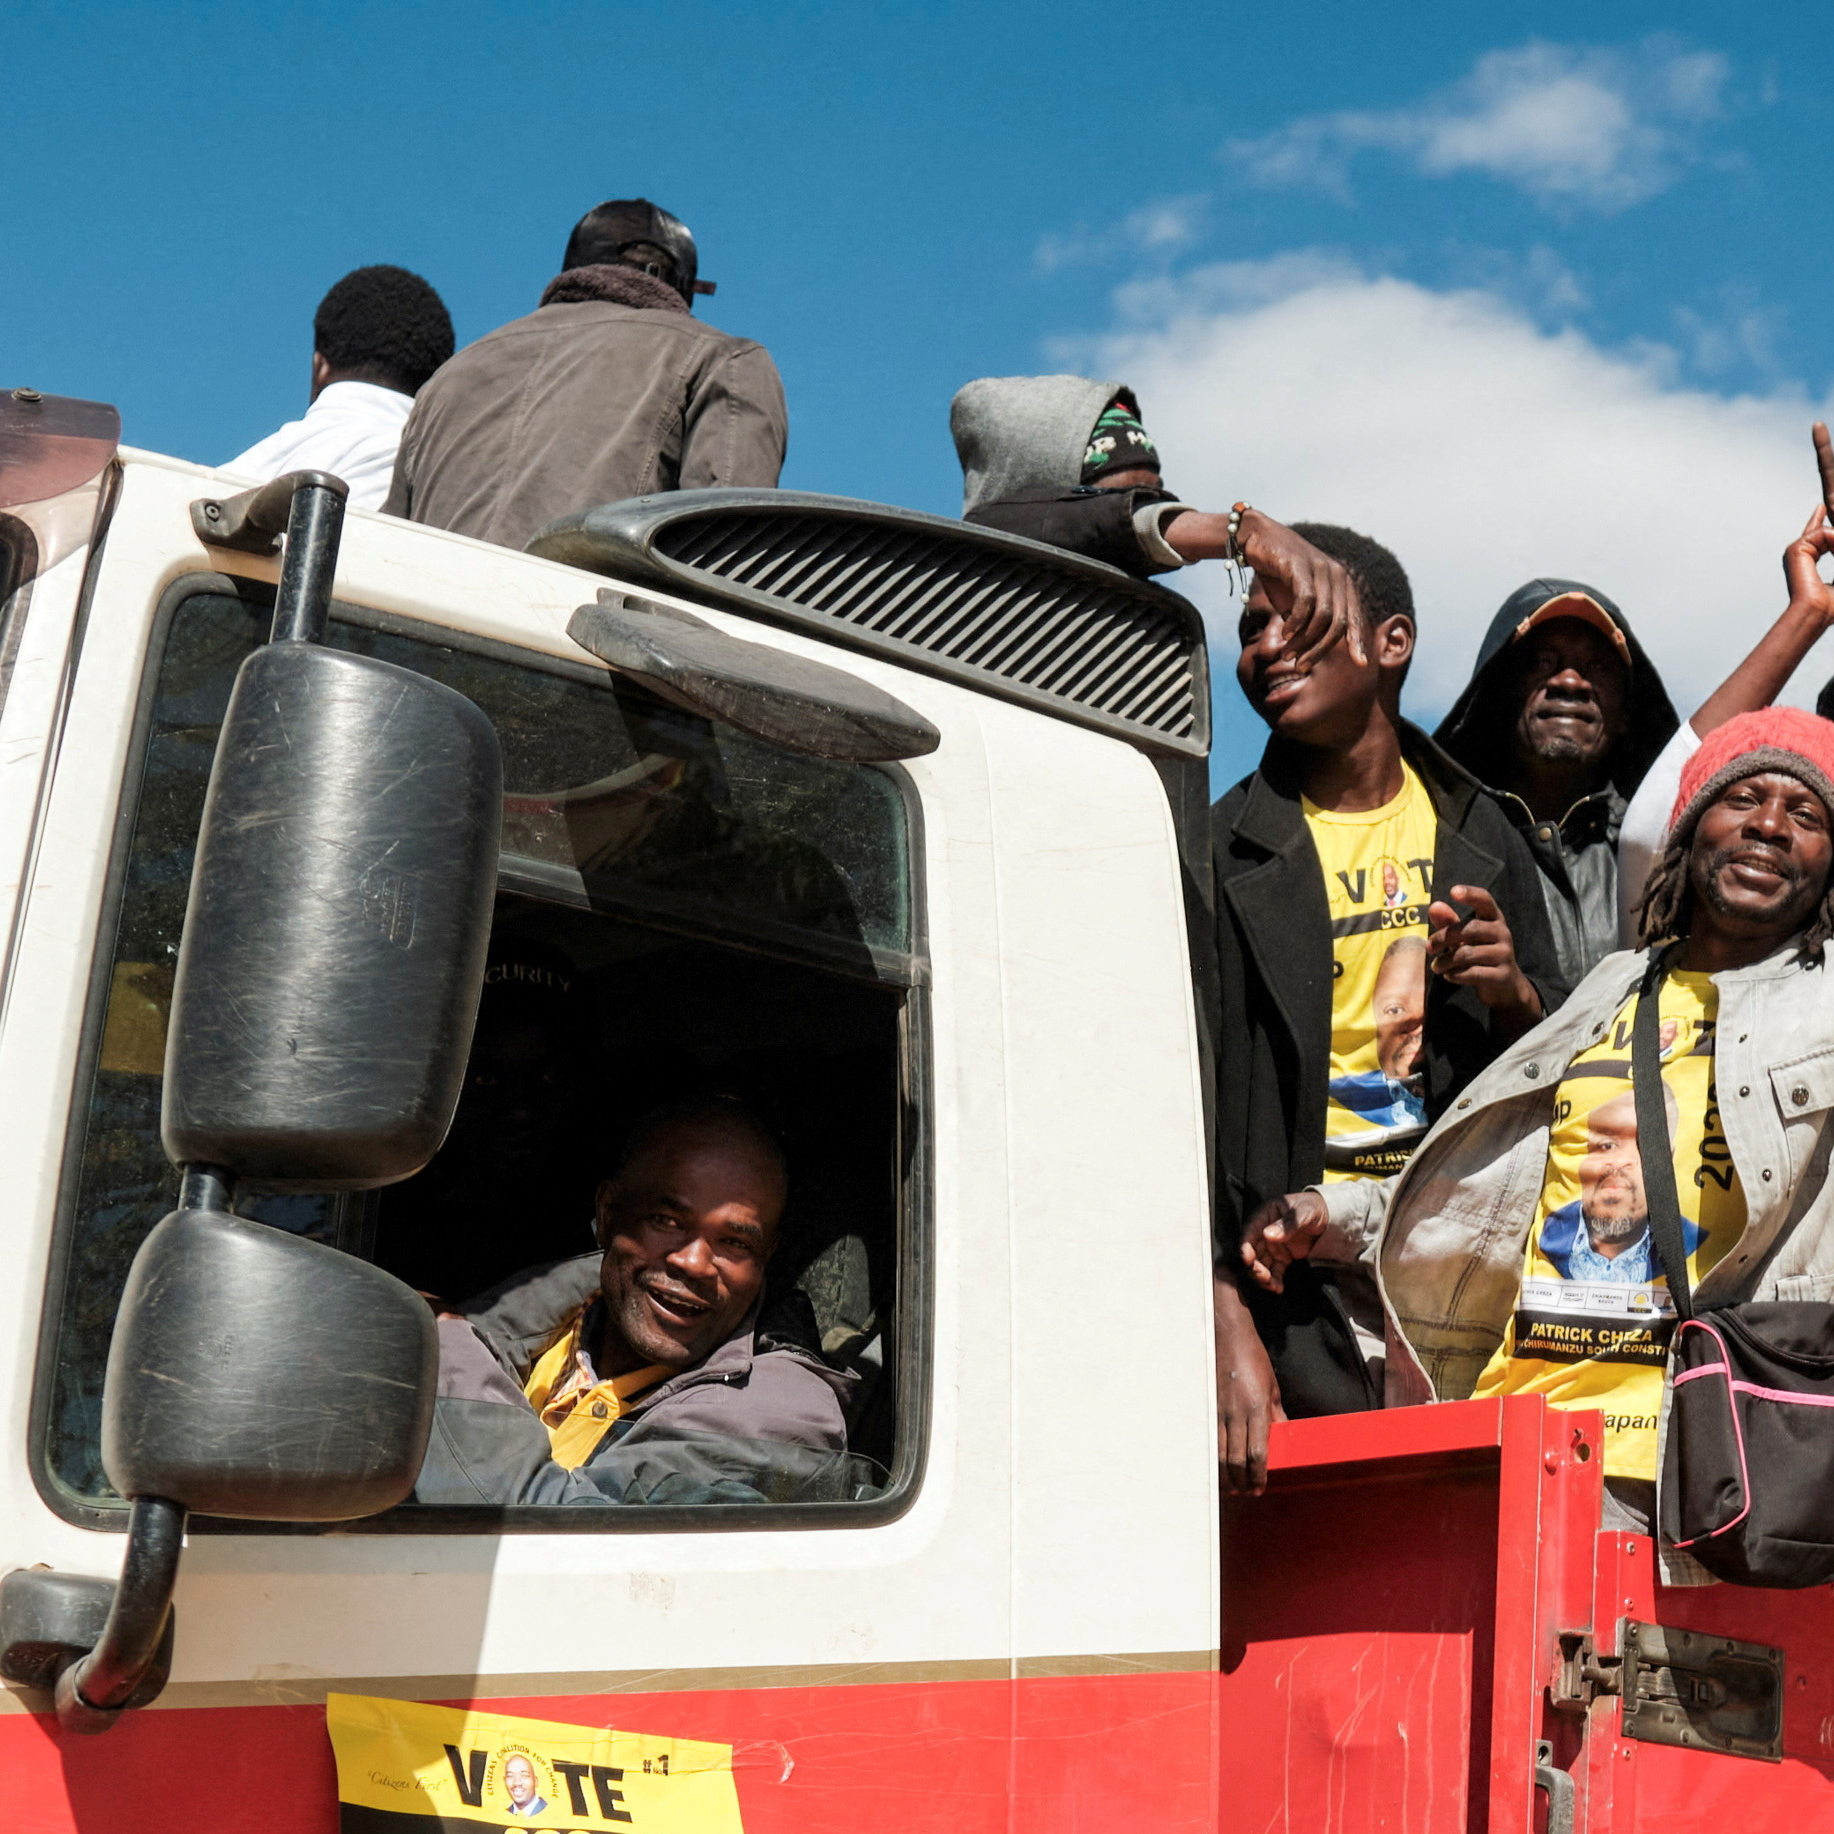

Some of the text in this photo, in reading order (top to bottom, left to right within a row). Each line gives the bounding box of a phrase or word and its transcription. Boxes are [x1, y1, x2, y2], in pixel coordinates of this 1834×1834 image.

[1381, 907, 1420, 930] CCC
[485, 964, 570, 992] CURITY
[1355, 1148, 1415, 1165] PATRIC
[1531, 1323, 1593, 1342] PATRICK
[443, 1744, 633, 1823] VTE
